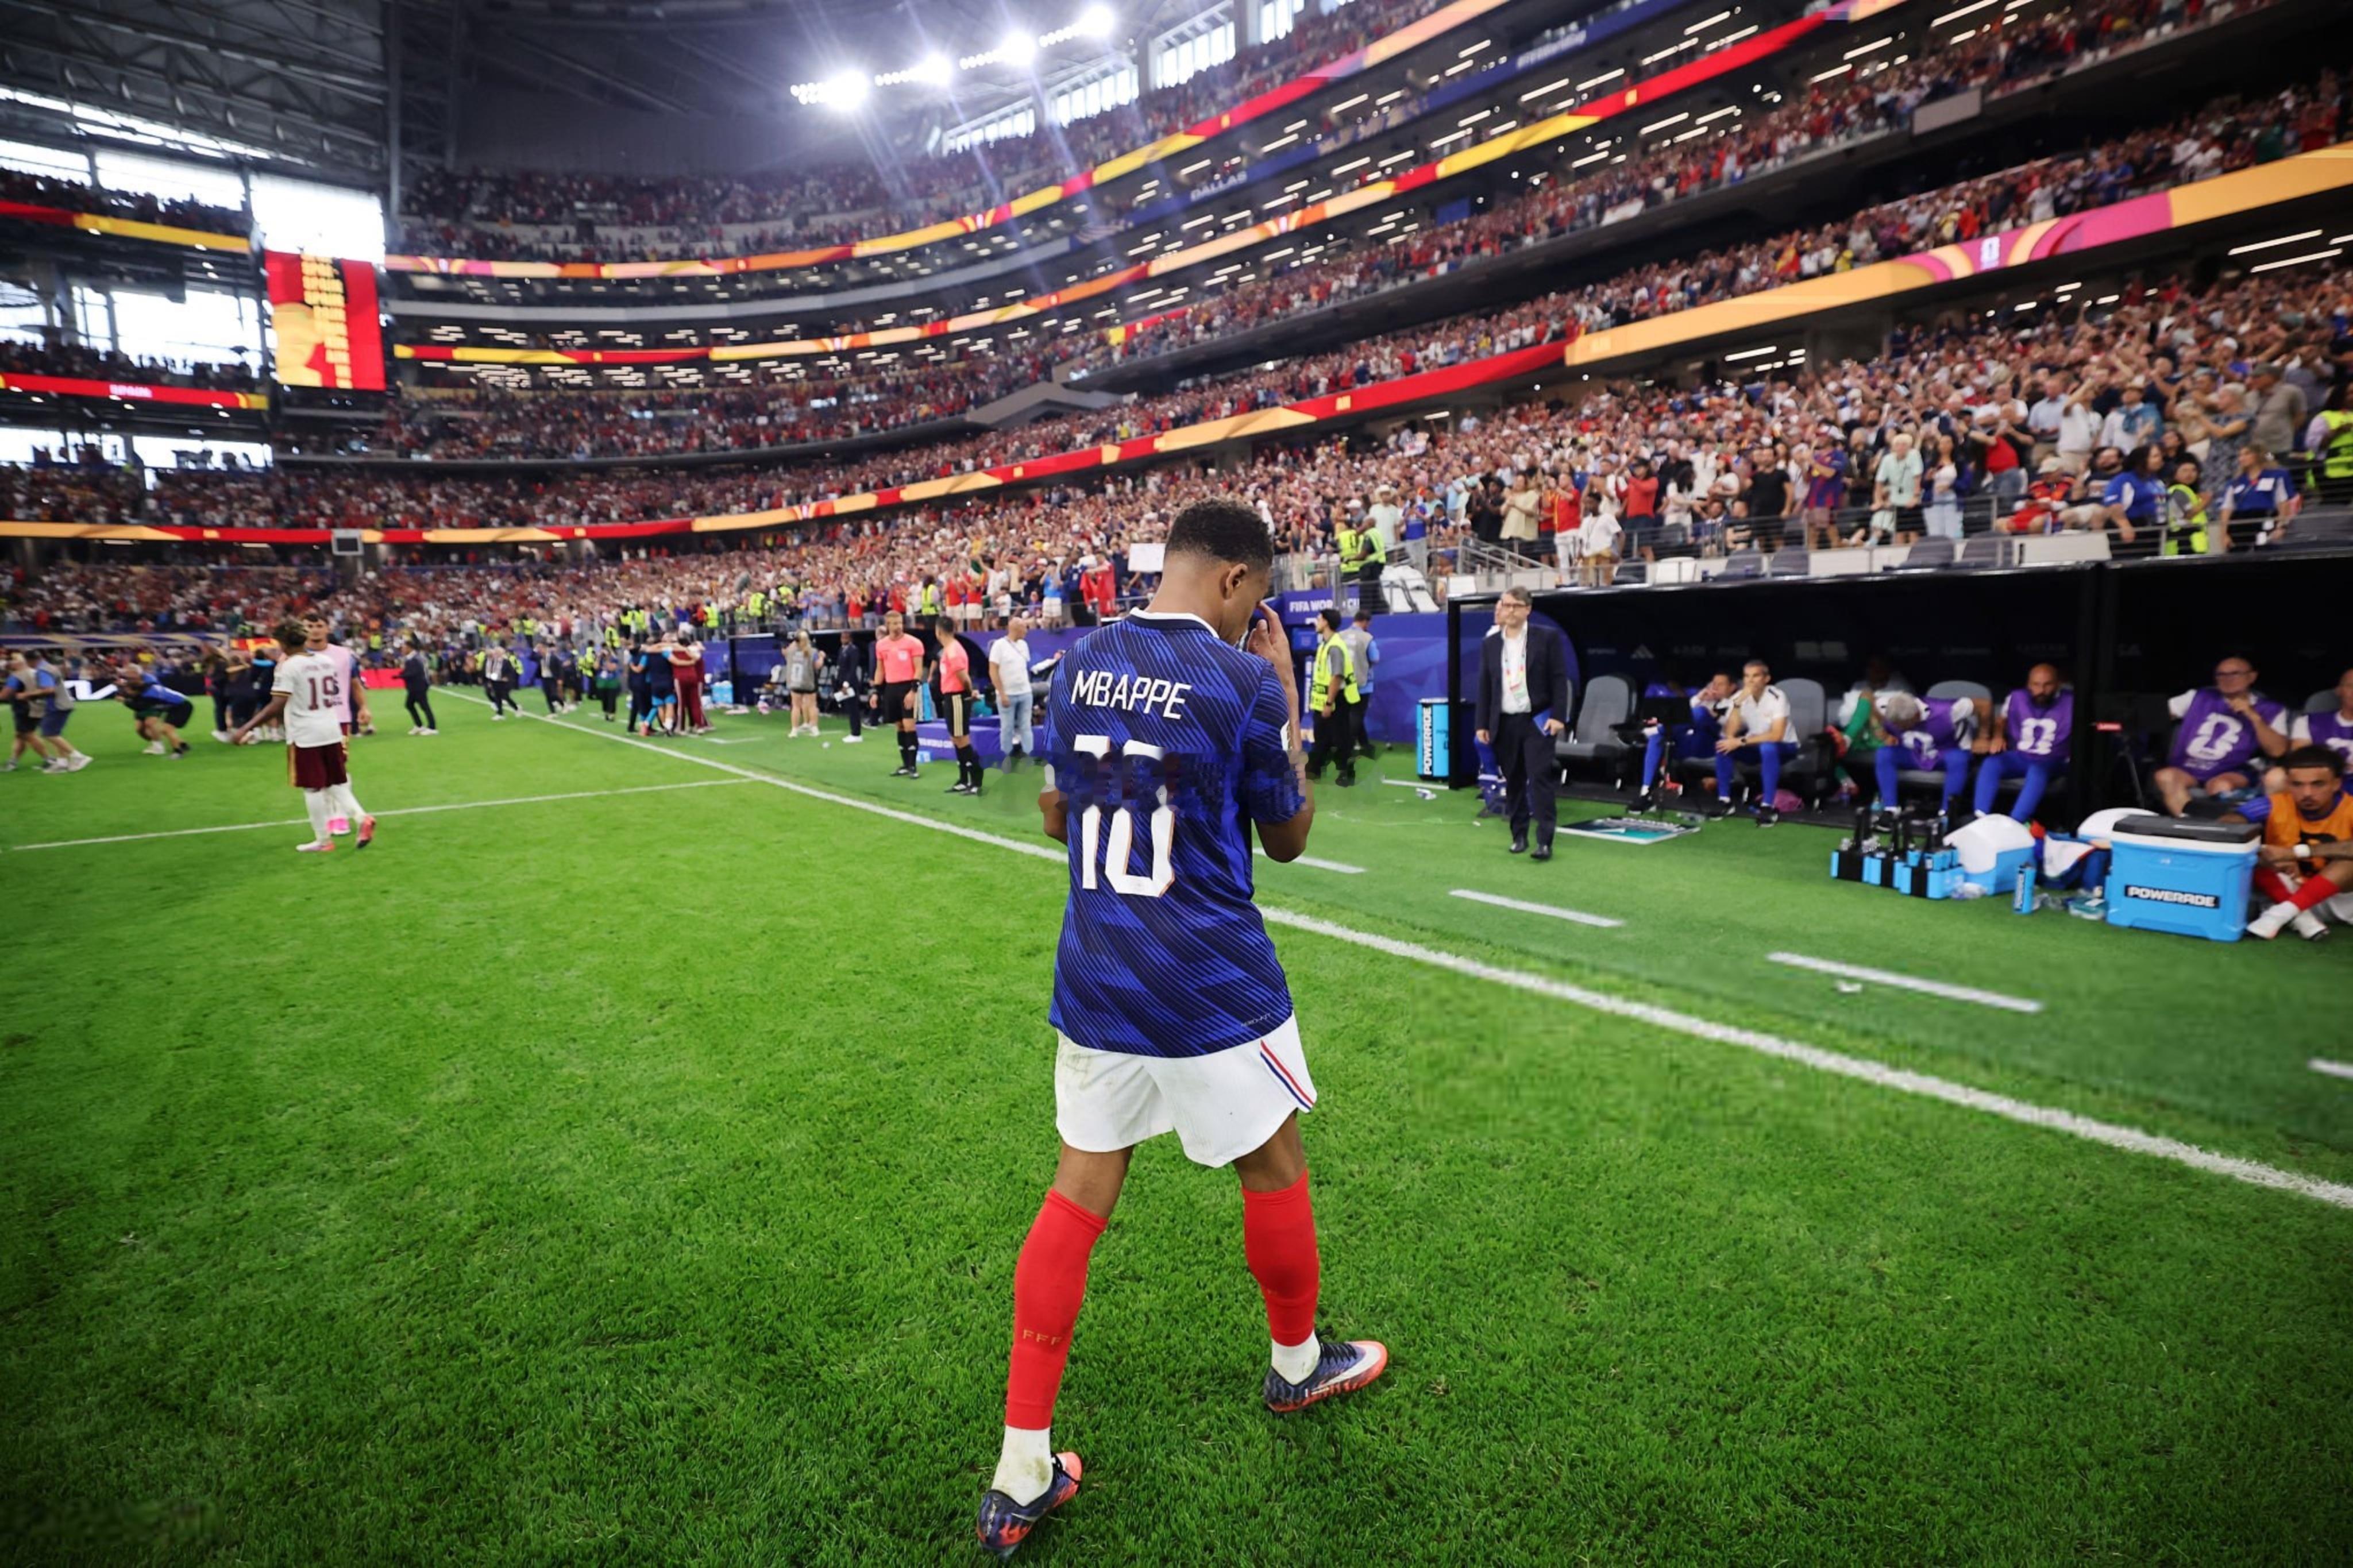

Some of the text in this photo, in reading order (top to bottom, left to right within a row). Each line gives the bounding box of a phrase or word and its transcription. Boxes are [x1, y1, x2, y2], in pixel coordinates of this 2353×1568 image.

[1289, 601, 1309, 612] FIFA
[1071, 670, 1192, 719] MBAPPE
[1423, 706, 1432, 775] POWERADE
[2128, 886, 2215, 907] POWERADE
[1023, 1329, 1063, 1346] FFF
